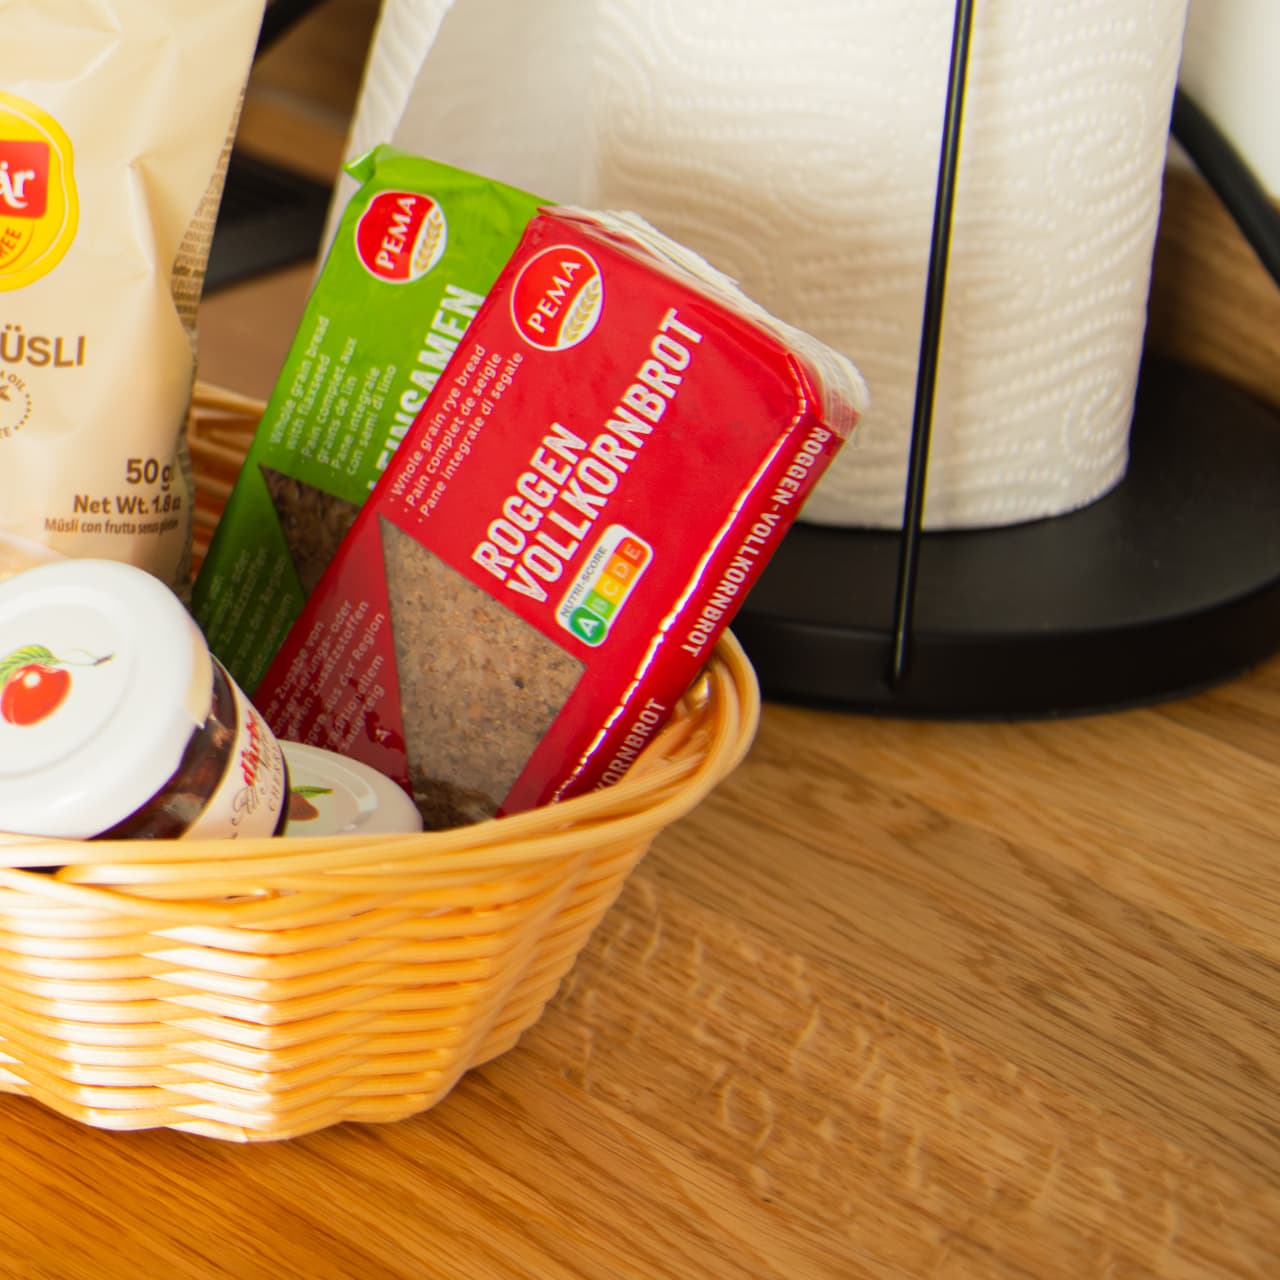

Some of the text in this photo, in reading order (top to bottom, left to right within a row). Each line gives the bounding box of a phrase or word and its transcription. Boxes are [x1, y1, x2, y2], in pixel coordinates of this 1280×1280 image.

[374, 197, 417, 270] PEMA
[527, 260, 582, 333] PEMA
[7, 373, 27, 392] OIL
[290, 360, 315, 398] grain
[307, 316, 330, 358] bread
[302, 337, 357, 456] Pain complet aux
[367, 284, 486, 490] NSAMEN
[332, 366, 384, 469] Pane integrale
[335, 399, 348, 416] de
[347, 364, 397, 477] con semi di lino
[391, 344, 487, 496] Whole grain rye bread
[406, 352, 503, 507] Pain complet de seigle
[420, 352, 524, 517] Pane integrale di segale
[126, 458, 159, 484] 50
[471, 422, 588, 581] ROGGEN
[506, 307, 704, 603] VOLLKORNBROT
[44, 518, 80, 533] Müsli
[81, 520, 102, 533] con
[104, 520, 136, 534] frutta
[73, 494, 111, 514] Net
[116, 495, 149, 514] Wt.
[680, 426, 834, 658] ROGGEN-VOLLKORNBROT
[559, 545, 608, 619] NUTRI-SCORE
[575, 616, 600, 638] A
[603, 578, 619, 597] C
[616, 562, 632, 580] D
[630, 545, 644, 561] E
[271, 600, 351, 734] onservierungs- oder
[306, 620, 322, 646] von
[308, 599, 371, 695] Zusatzstoffen
[352, 611, 386, 661] Region
